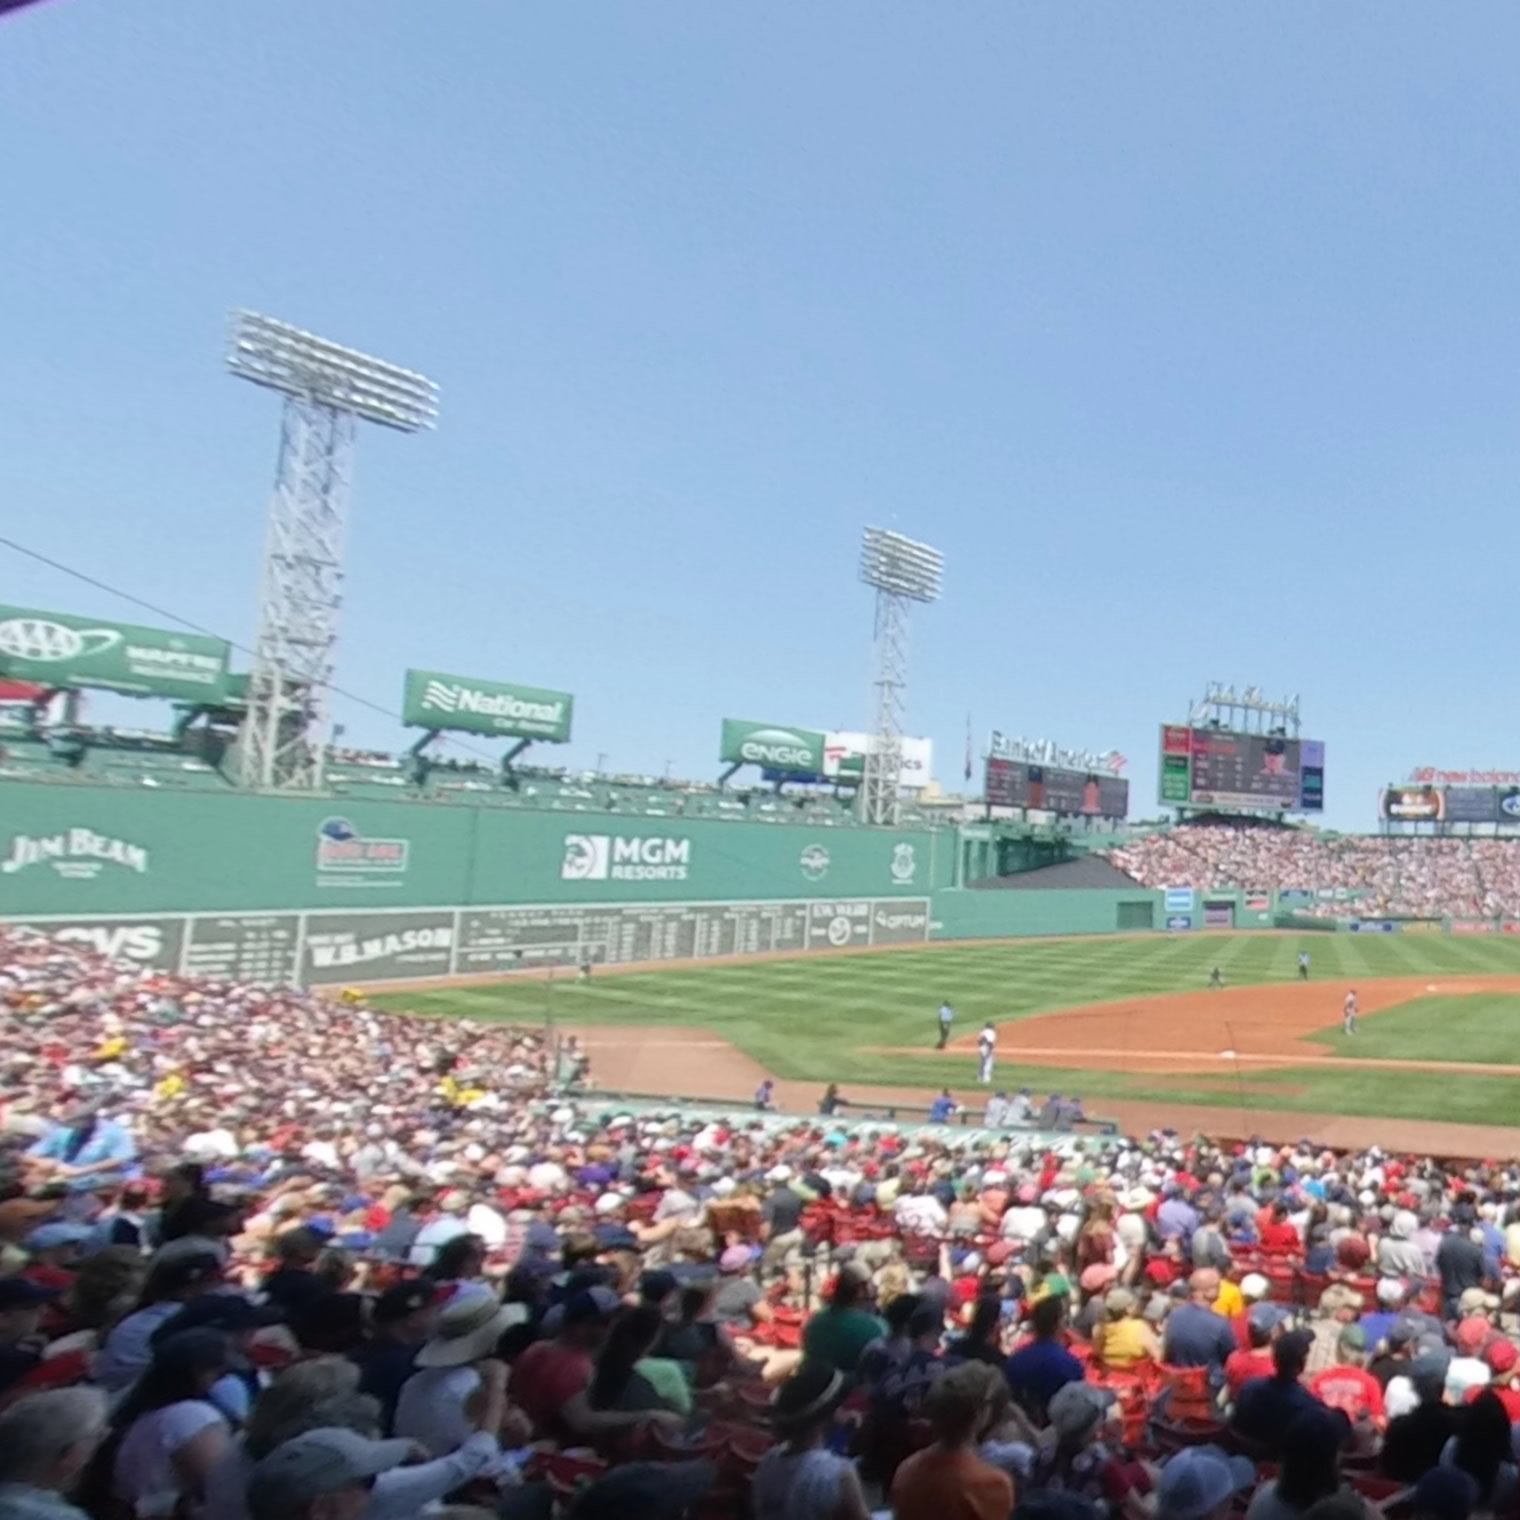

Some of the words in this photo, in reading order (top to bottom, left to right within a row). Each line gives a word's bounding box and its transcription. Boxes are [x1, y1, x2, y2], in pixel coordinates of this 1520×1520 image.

[457, 687, 563, 723] National
[2, 835, 64, 873] JIM
[69, 827, 147, 873] BEAM
[614, 836, 690, 864] MGM
[611, 865, 688, 879] RESORTS
